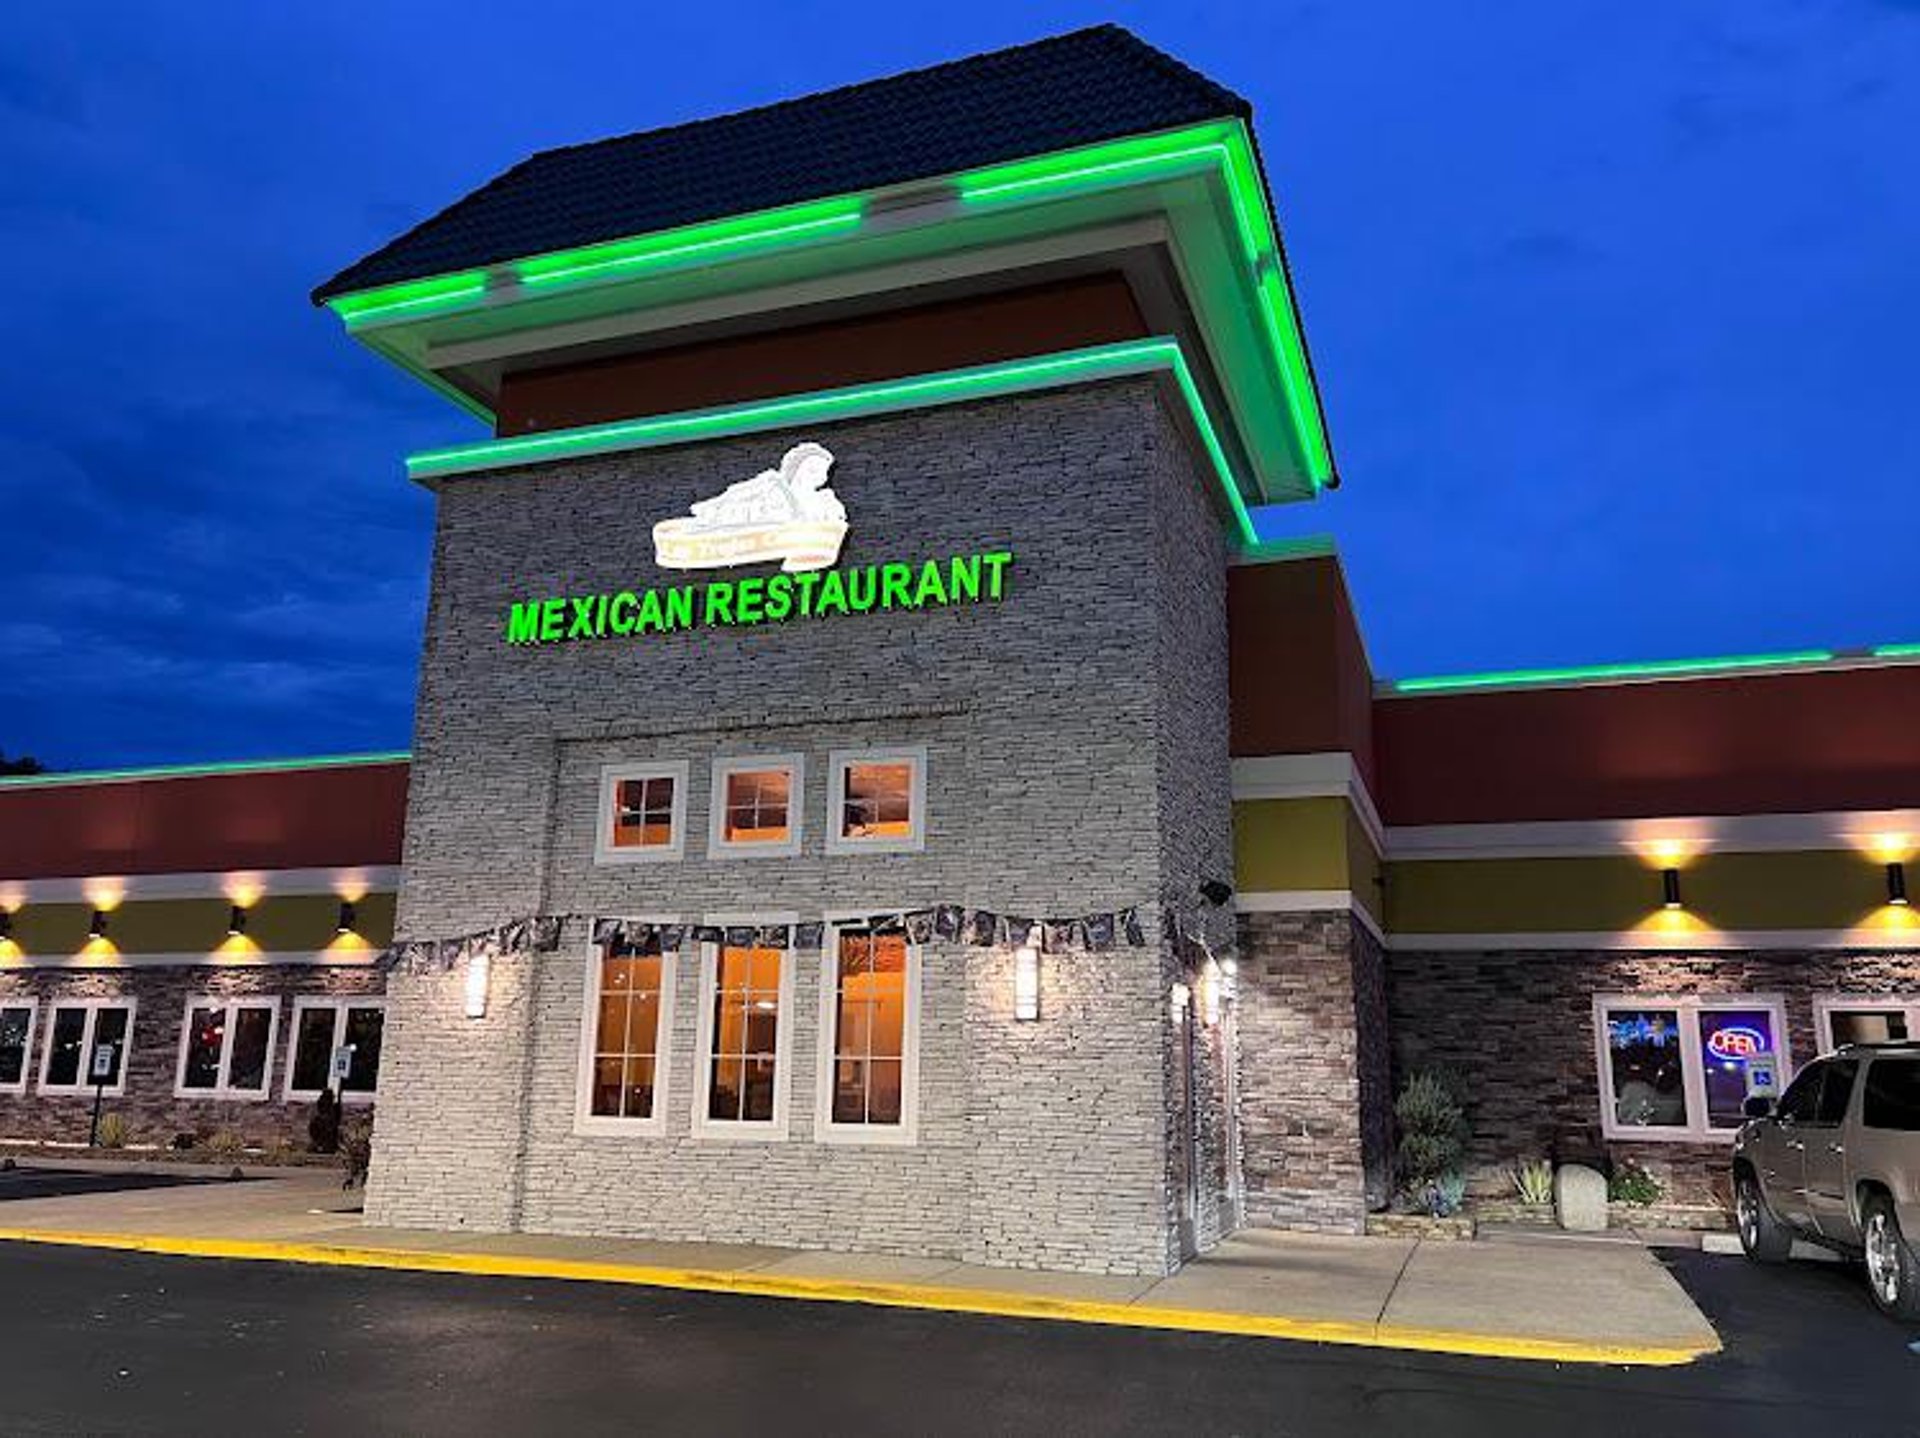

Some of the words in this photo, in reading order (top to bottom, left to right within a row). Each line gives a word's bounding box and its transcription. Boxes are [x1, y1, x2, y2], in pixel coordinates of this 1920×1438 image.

[507, 585, 694, 642] MEXICAN
[705, 552, 1012, 625] RESTAURANT
[1711, 1031, 1758, 1055] OPEN
